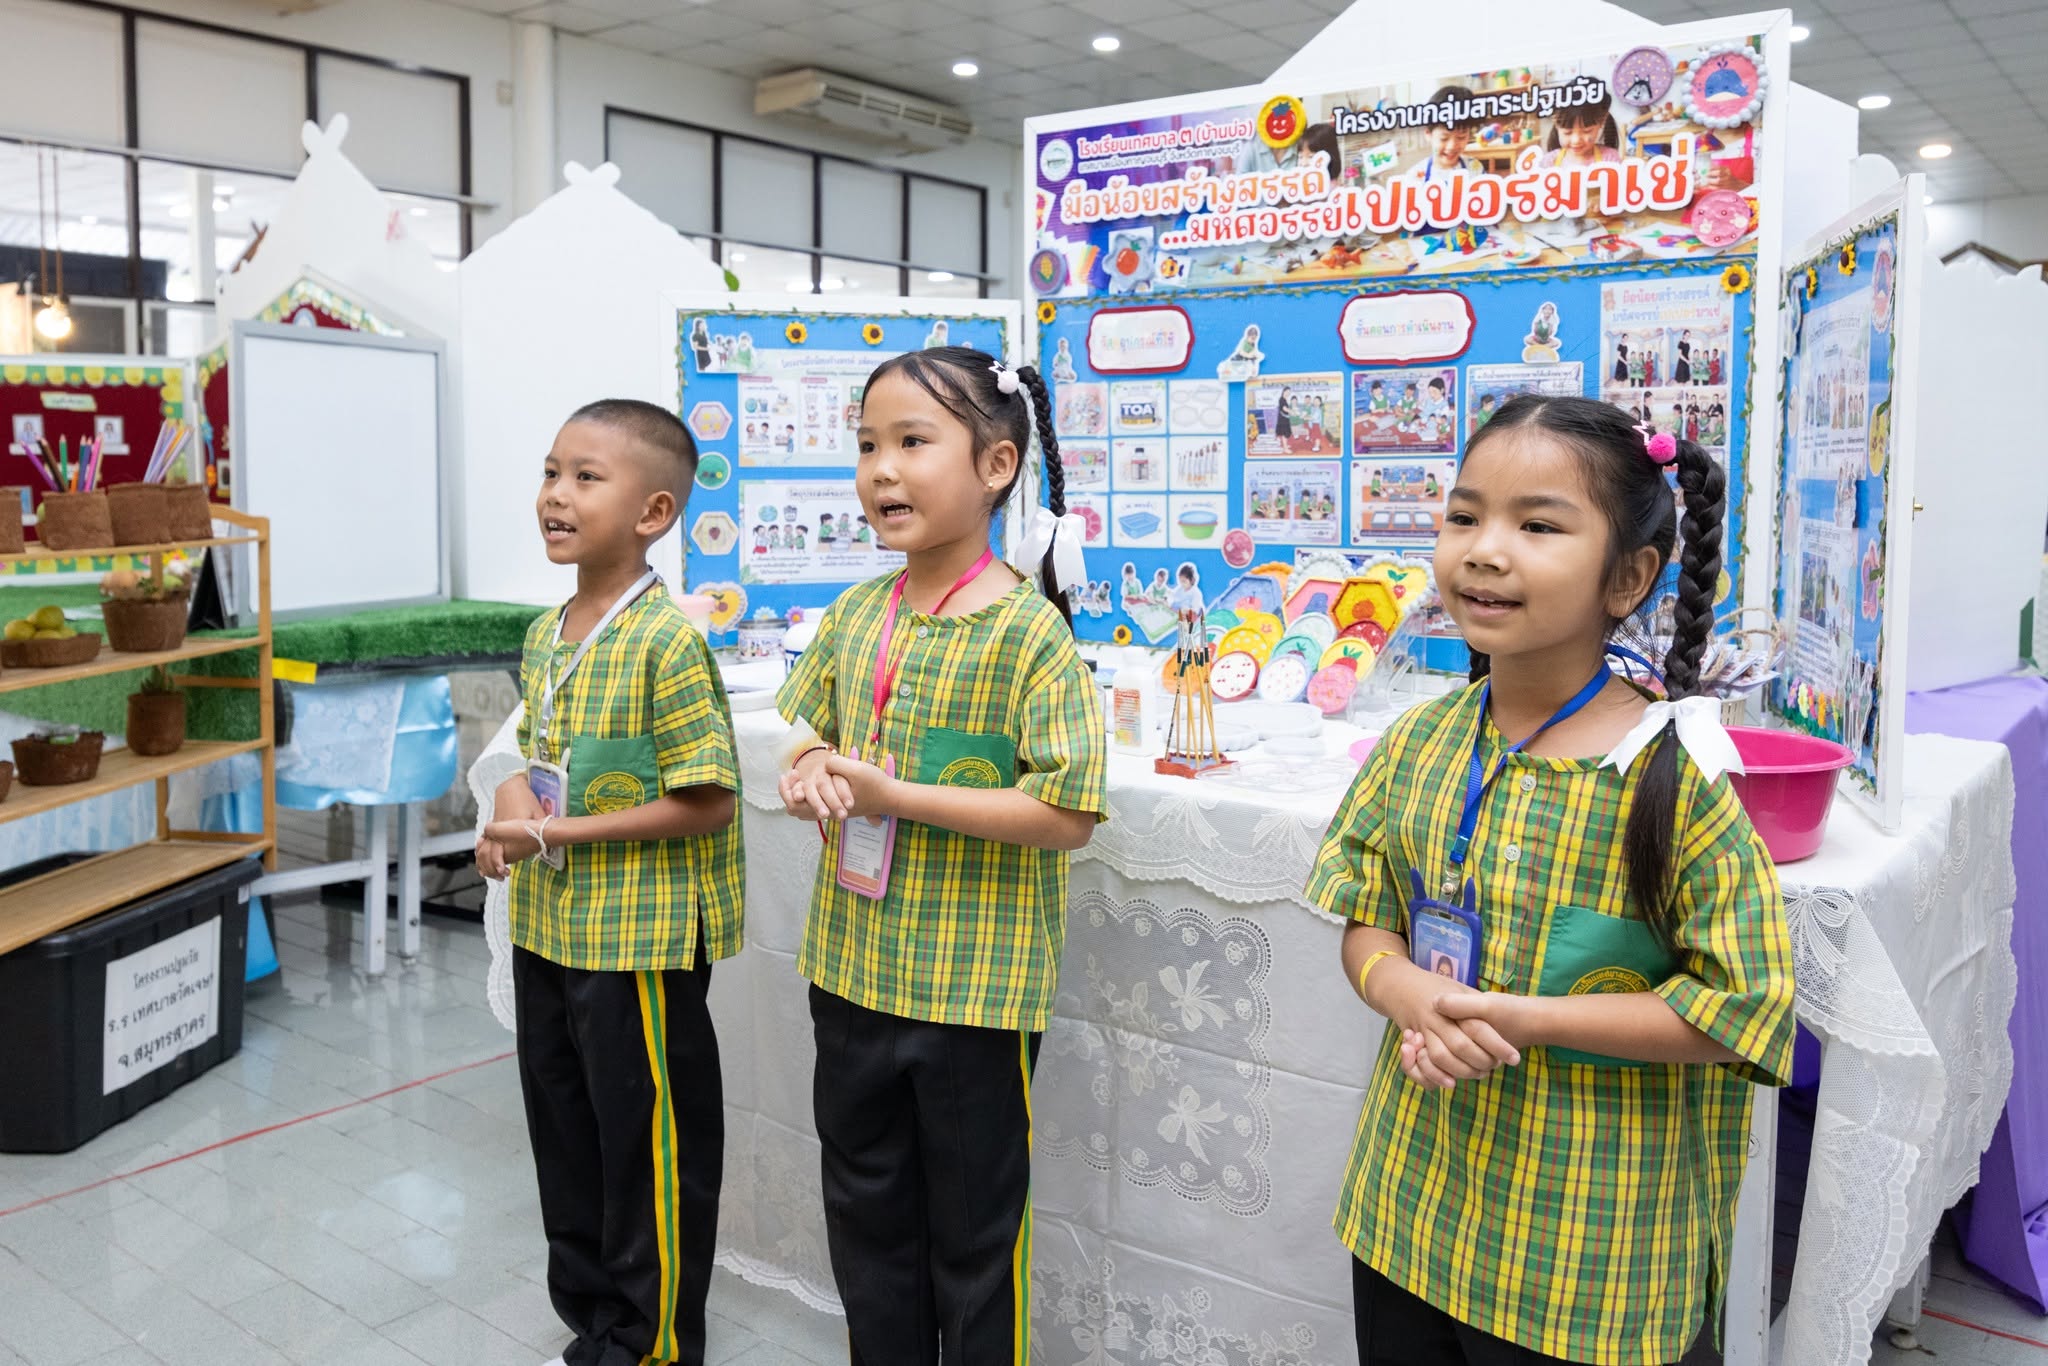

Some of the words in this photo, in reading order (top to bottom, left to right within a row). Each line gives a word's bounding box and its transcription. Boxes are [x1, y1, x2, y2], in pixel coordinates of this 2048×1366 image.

[1333, 77, 1606, 136] โครงงานกลุ่มสาระปฐมวัย
[1078, 134, 1176, 156] โรงเรียนเทศบาล
[1196, 121, 1253, 144] (บ้านบ่อ)
[1063, 157, 1325, 219] มือน้อยสร้างสรรค์
[1122, 404, 1153, 416] TOA
